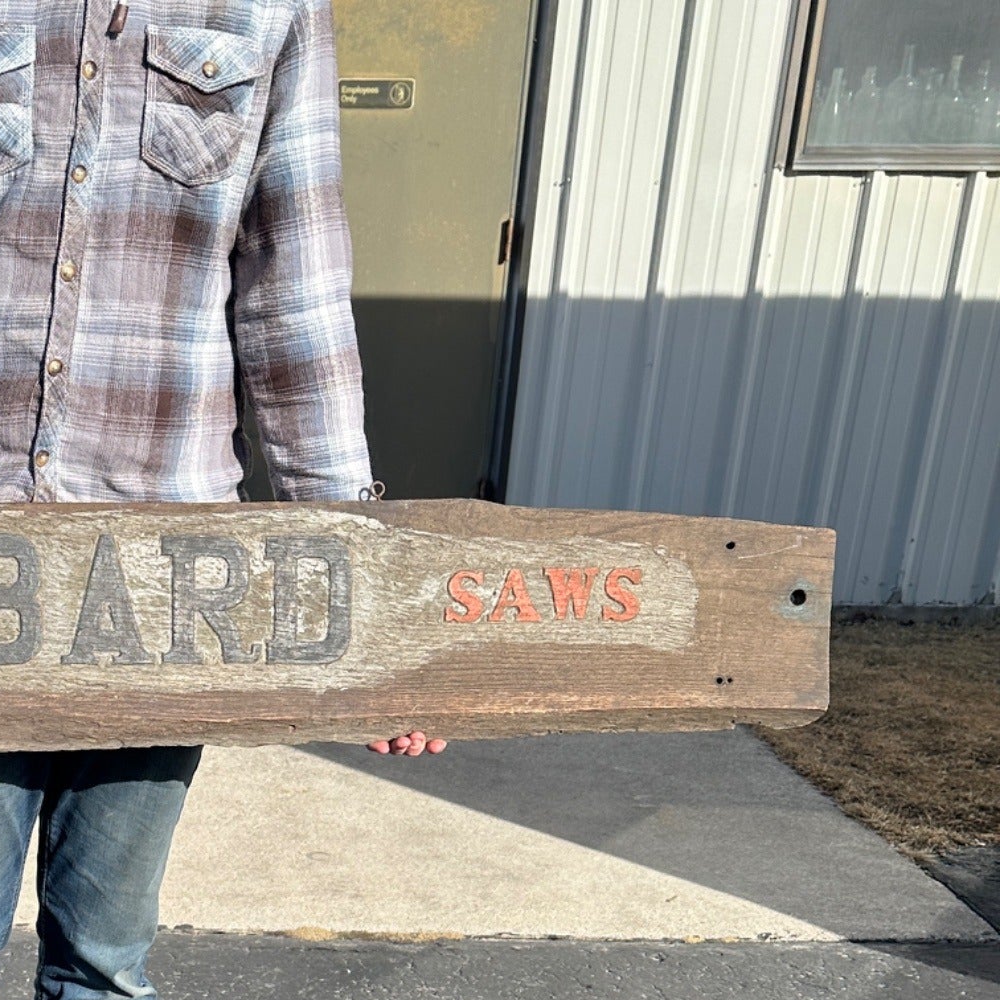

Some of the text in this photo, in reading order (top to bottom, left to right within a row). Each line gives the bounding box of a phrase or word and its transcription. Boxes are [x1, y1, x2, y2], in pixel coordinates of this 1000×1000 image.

[341, 85, 379, 95] Employees
[340, 94, 357, 104] Only
[444, 566, 642, 623] SAWS
